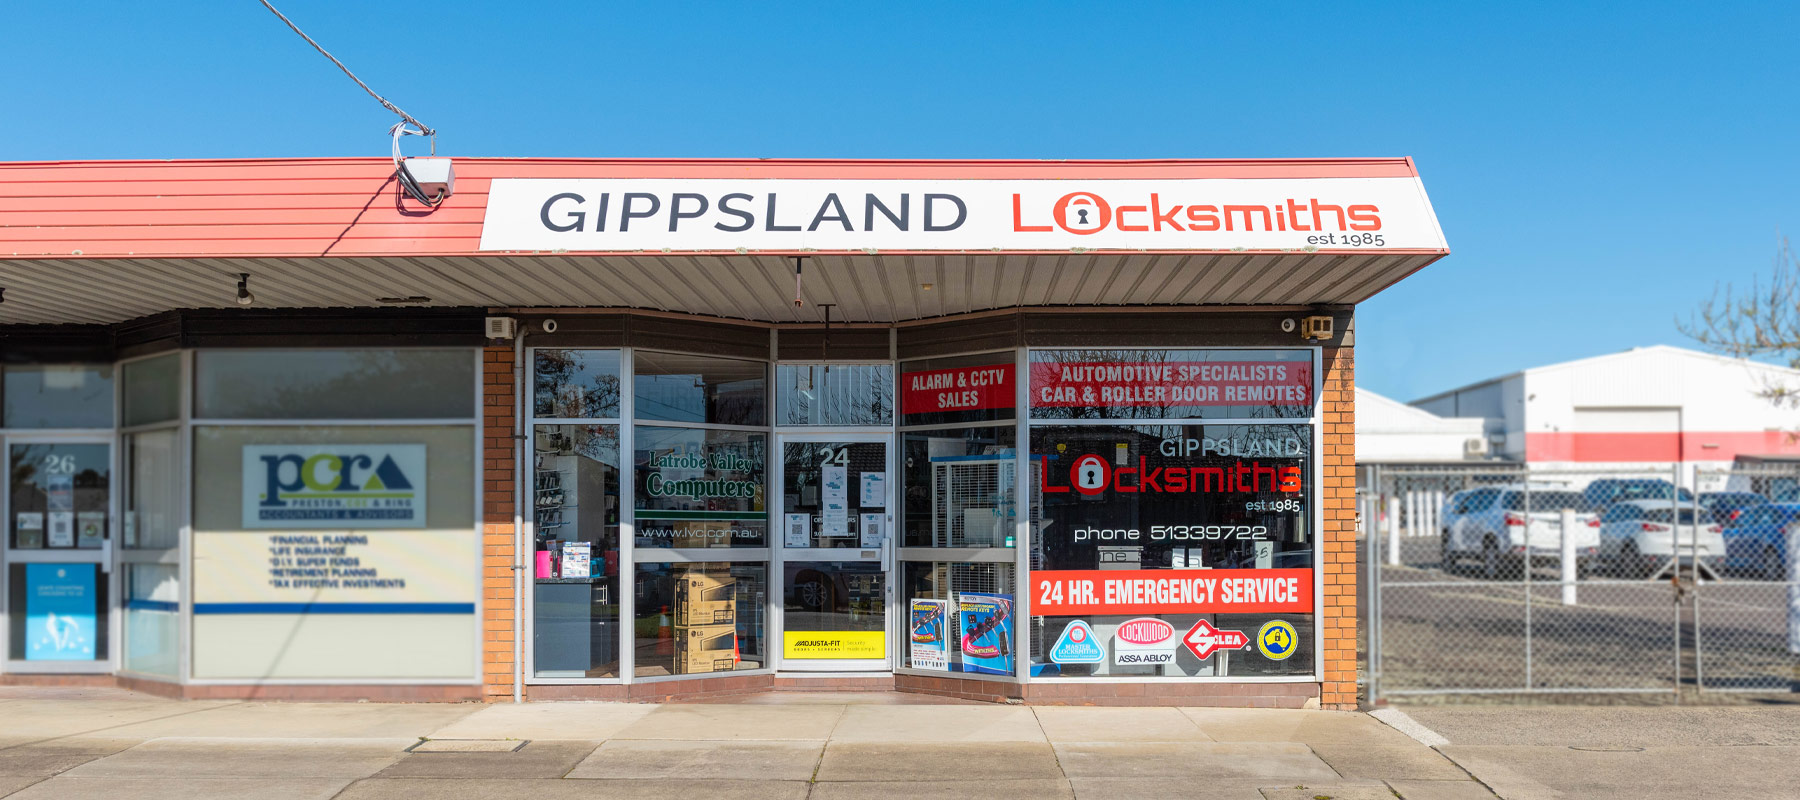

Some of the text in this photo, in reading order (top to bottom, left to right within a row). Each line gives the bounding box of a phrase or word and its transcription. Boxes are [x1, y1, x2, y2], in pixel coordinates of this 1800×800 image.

[540, 192, 968, 232] GIPPSLAND
[1307, 232, 1385, 246] est 1985
[912, 369, 1004, 391] ALARM & CCTV
[1061, 366, 1287, 382] AUTOMOTIVE SPECIALISTS
[938, 391, 979, 408] SALES
[1041, 386, 1306, 402] CAR & ROLLER DOOR REMOTES
[1159, 438, 1301, 458] GIPPSLAND
[45, 454, 76, 474] 26
[649, 451, 752, 474] Latrobe Valley
[820, 448, 850, 468] 24
[647, 472, 756, 502] Computers
[1245, 500, 1300, 512] est 1985
[322, 536, 368, 545] PLANNING
[641, 527, 758, 538] www.lvc.com.au
[1074, 526, 1268, 542] phone 51339722
[294, 546, 346, 556] INSURANCE
[332, 568, 377, 578] PLANNING
[342, 578, 406, 588] INVESTMENTS
[1040, 578, 1298, 605] 24 HR. EMERGENCY SERVICE
[1122, 622, 1169, 642] LOCKWOOD
[1118, 654, 1172, 663] ASSA ABLOY
